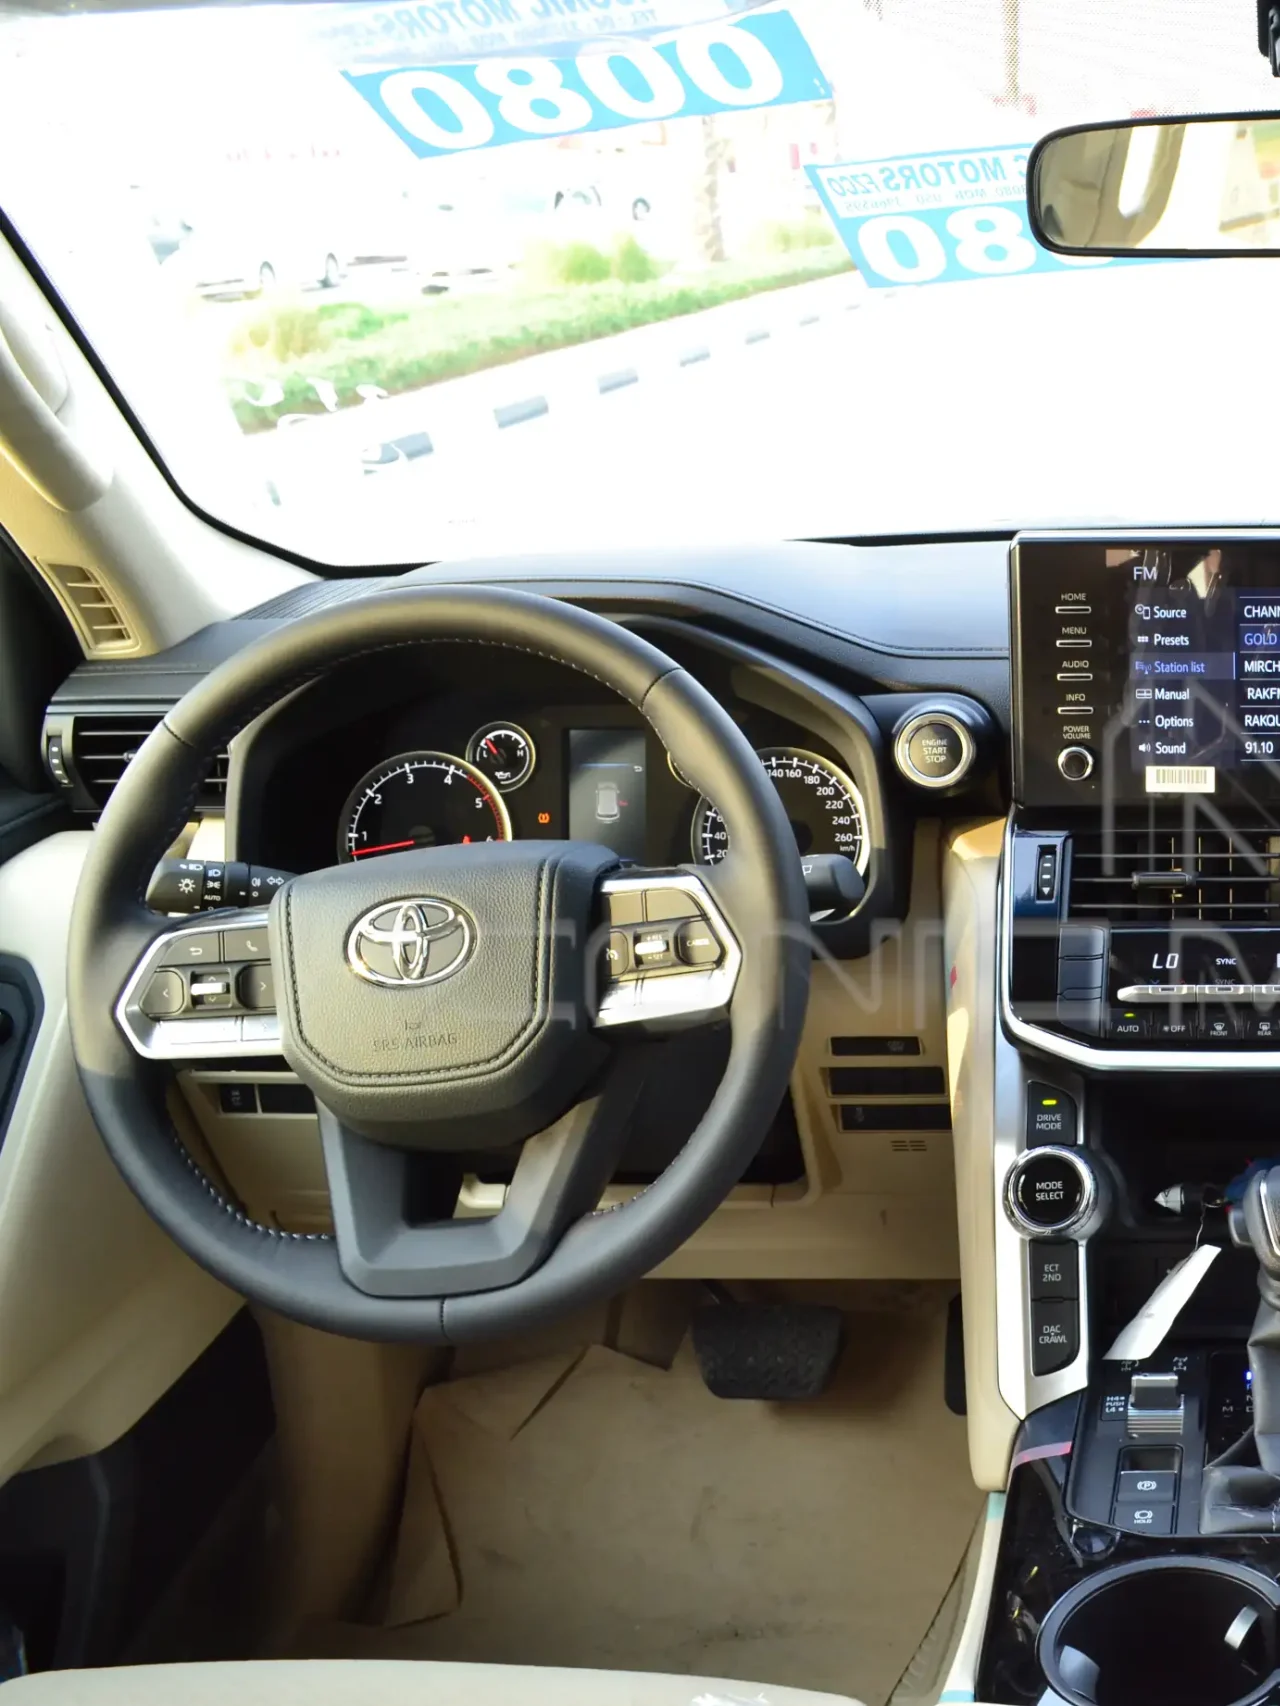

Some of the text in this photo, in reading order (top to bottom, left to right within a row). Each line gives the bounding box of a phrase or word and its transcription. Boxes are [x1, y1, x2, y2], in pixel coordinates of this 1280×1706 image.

[1133, 566, 1158, 581] FM
[1061, 593, 1087, 601] HOME
[1153, 606, 1187, 619] Source
[1061, 627, 1087, 635] MENU
[1154, 633, 1189, 646] Presets
[1244, 633, 1277, 645] GOLD
[1062, 660, 1089, 669] AUDIO
[1154, 660, 1206, 673] Station list
[1065, 693, 1086, 701] INFO
[1155, 688, 1190, 700] Manual
[1155, 714, 1194, 729] Options
[1063, 725, 1090, 733] POWER
[1063, 732, 1091, 740] VOLUME
[922, 738, 948, 746] ENGINE
[923, 746, 947, 755] START
[1155, 742, 1187, 754] Sound
[1244, 741, 1274, 754] 91.10
[925, 755, 947, 764] STOP
[785, 768, 802, 778] 160
[406, 774, 415, 784] 3
[444, 774, 453, 785] 4
[803, 775, 820, 785] 180
[816, 786, 835, 796] 200
[374, 794, 383, 805] 2
[475, 797, 483, 808] 5
[825, 800, 844, 809] 220
[832, 816, 851, 825] 240
[362, 831, 368, 841] 1
[714, 831, 727, 840] 40
[834, 833, 853, 842] 260
[1215, 957, 1237, 965] SYNC
[1117, 1025, 1139, 1033] AUTO
[1170, 1025, 1186, 1033] OFF
[1036, 1113, 1062, 1122] DRIVE
[1035, 1122, 1062, 1130] MODE
[1036, 1181, 1063, 1190] MODE
[1035, 1191, 1064, 1201] SELECT
[1044, 1264, 1060, 1273] ECT
[1042, 1273, 1062, 1282] 2ND
[1042, 1325, 1061, 1334] DAC
[1039, 1335, 1067, 1344] CRAWL
